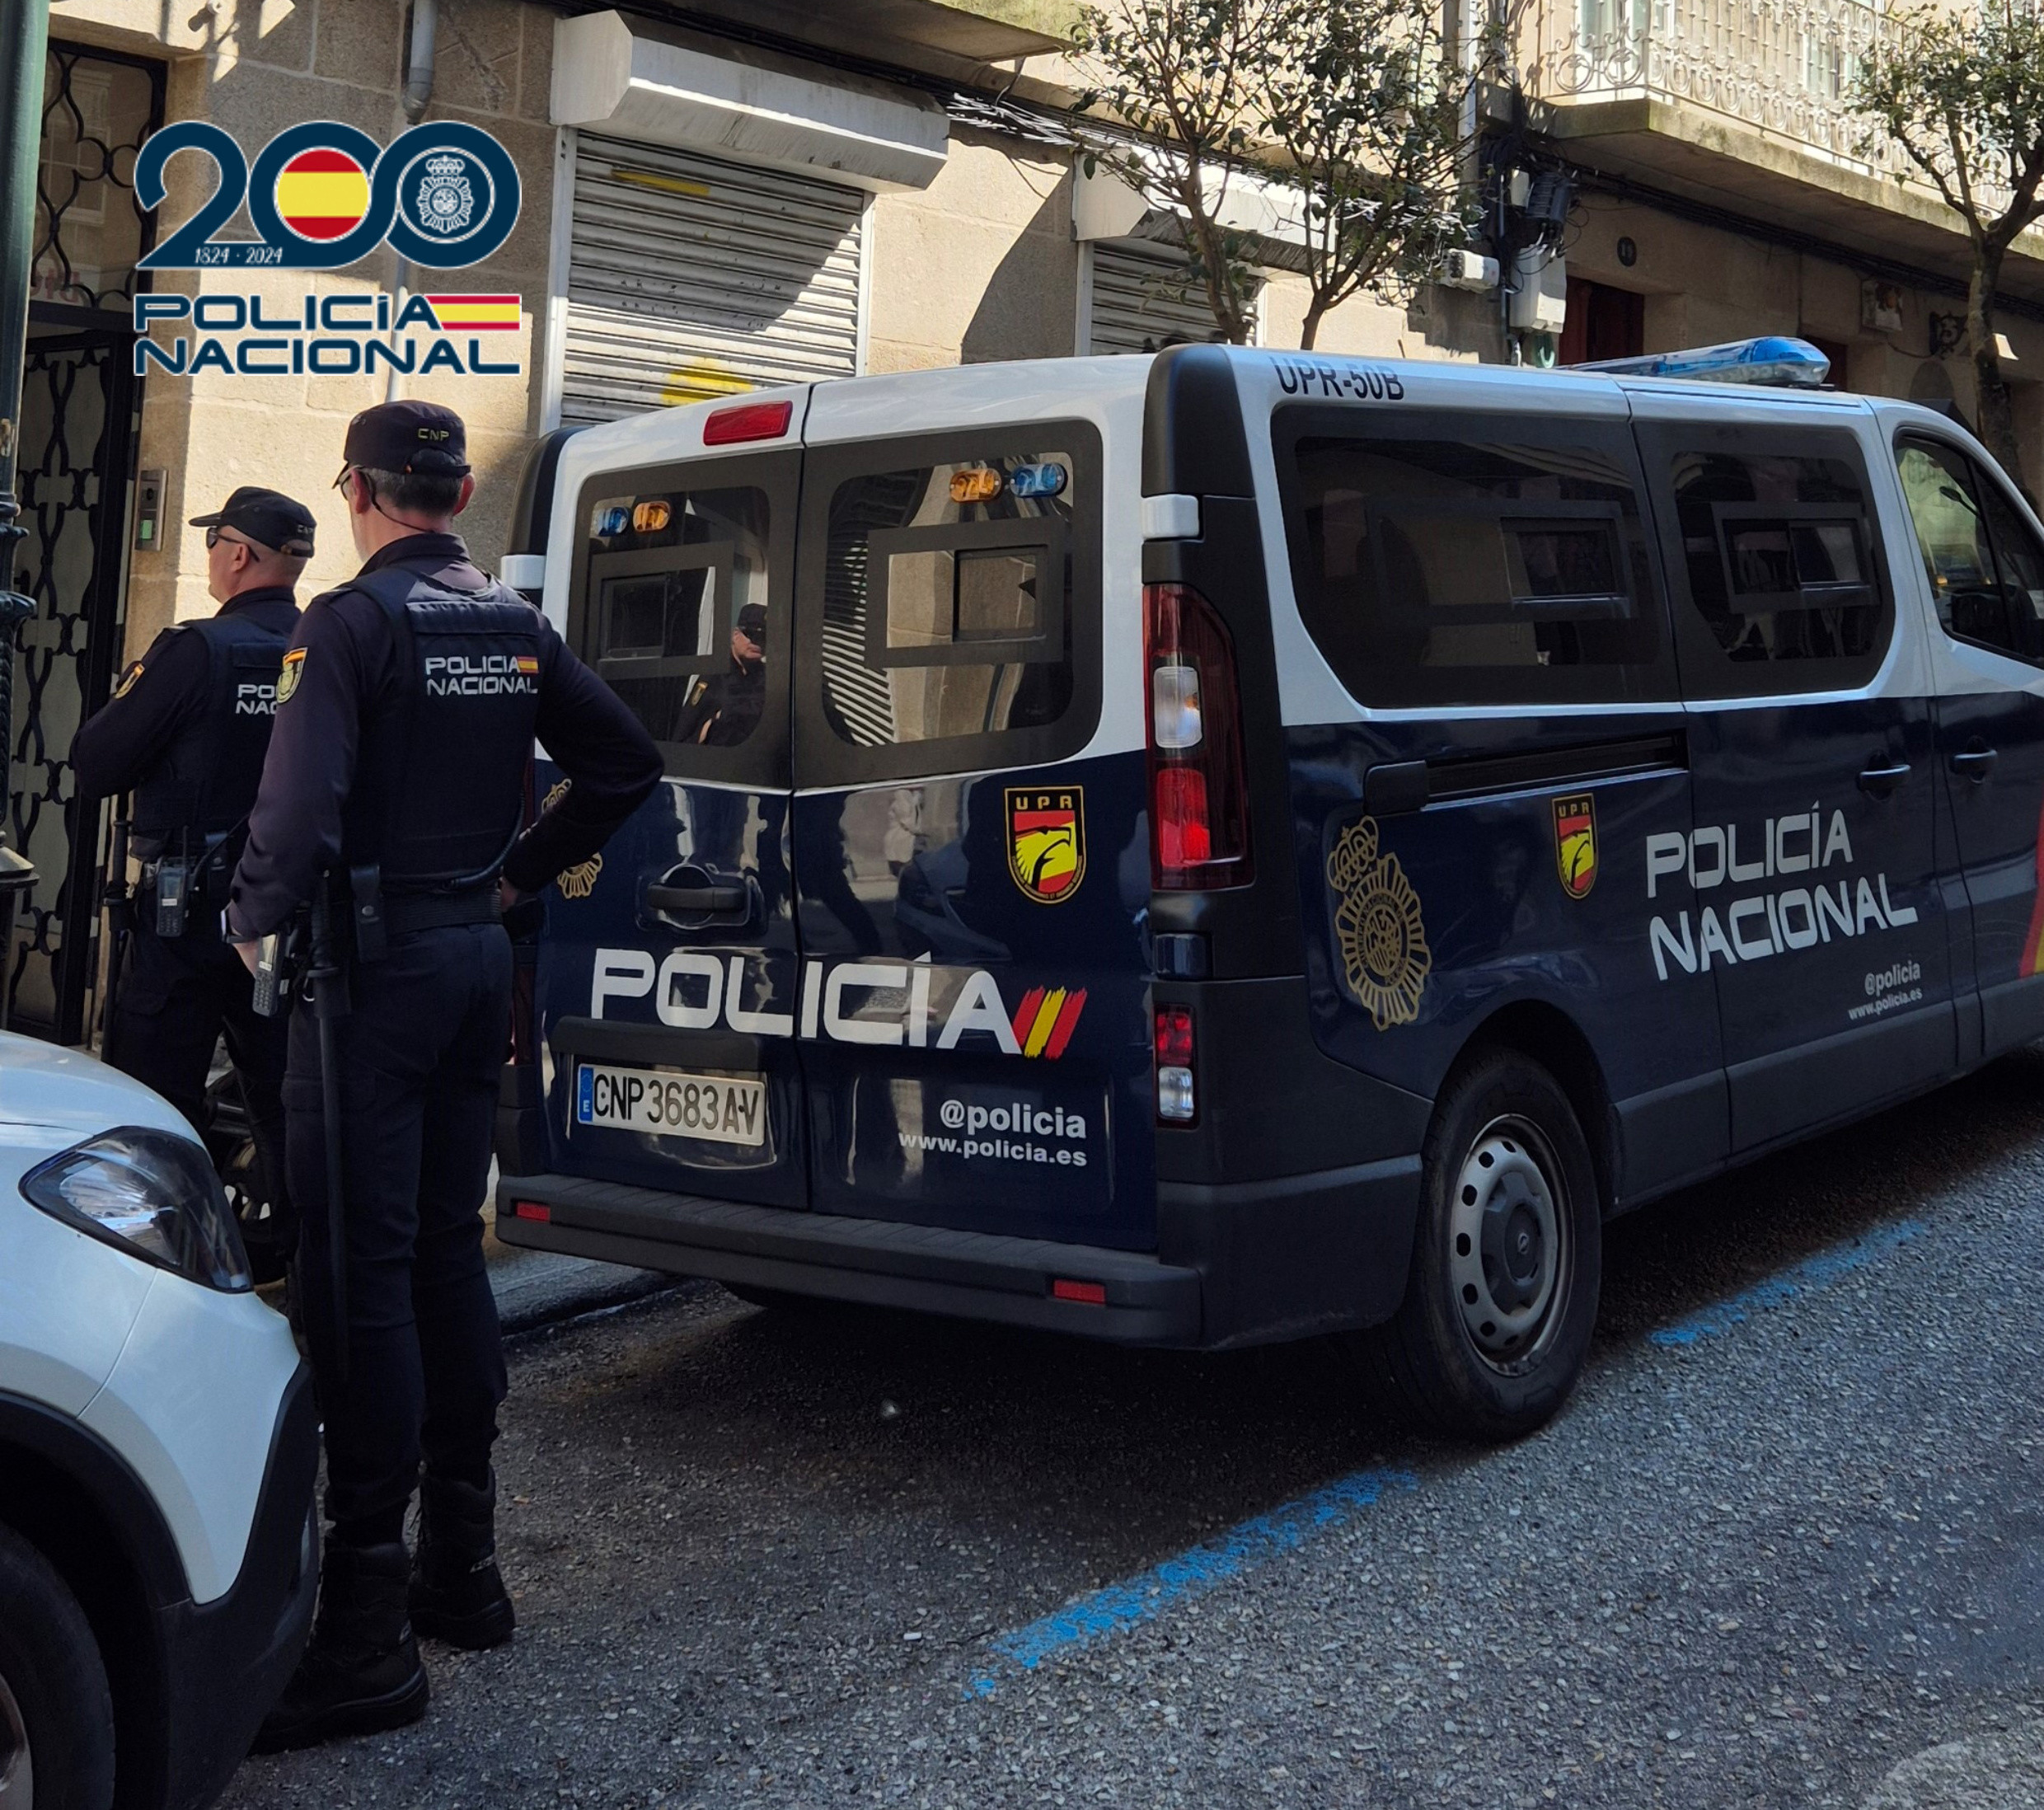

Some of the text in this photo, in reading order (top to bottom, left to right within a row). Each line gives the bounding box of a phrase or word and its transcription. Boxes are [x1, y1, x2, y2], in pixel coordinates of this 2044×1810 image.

[1269, 355, 1404, 401] UPR-50B
[418, 428, 450, 442] CNP
[426, 676, 538, 696] NACIONAL
[1015, 795, 1073, 810] UPR
[1646, 800, 1854, 898] POLICÍA
[1649, 873, 1919, 981] NACIONAL
[1864, 960, 1921, 997] @policia
[591, 948, 1022, 1054] POLICÍA
[1848, 987, 1923, 1020] www.policia.es
[583, 1100, 590, 1113] E
[940, 1099, 1086, 1139] @policia
[898, 1132, 1087, 1167] www.policia.es
